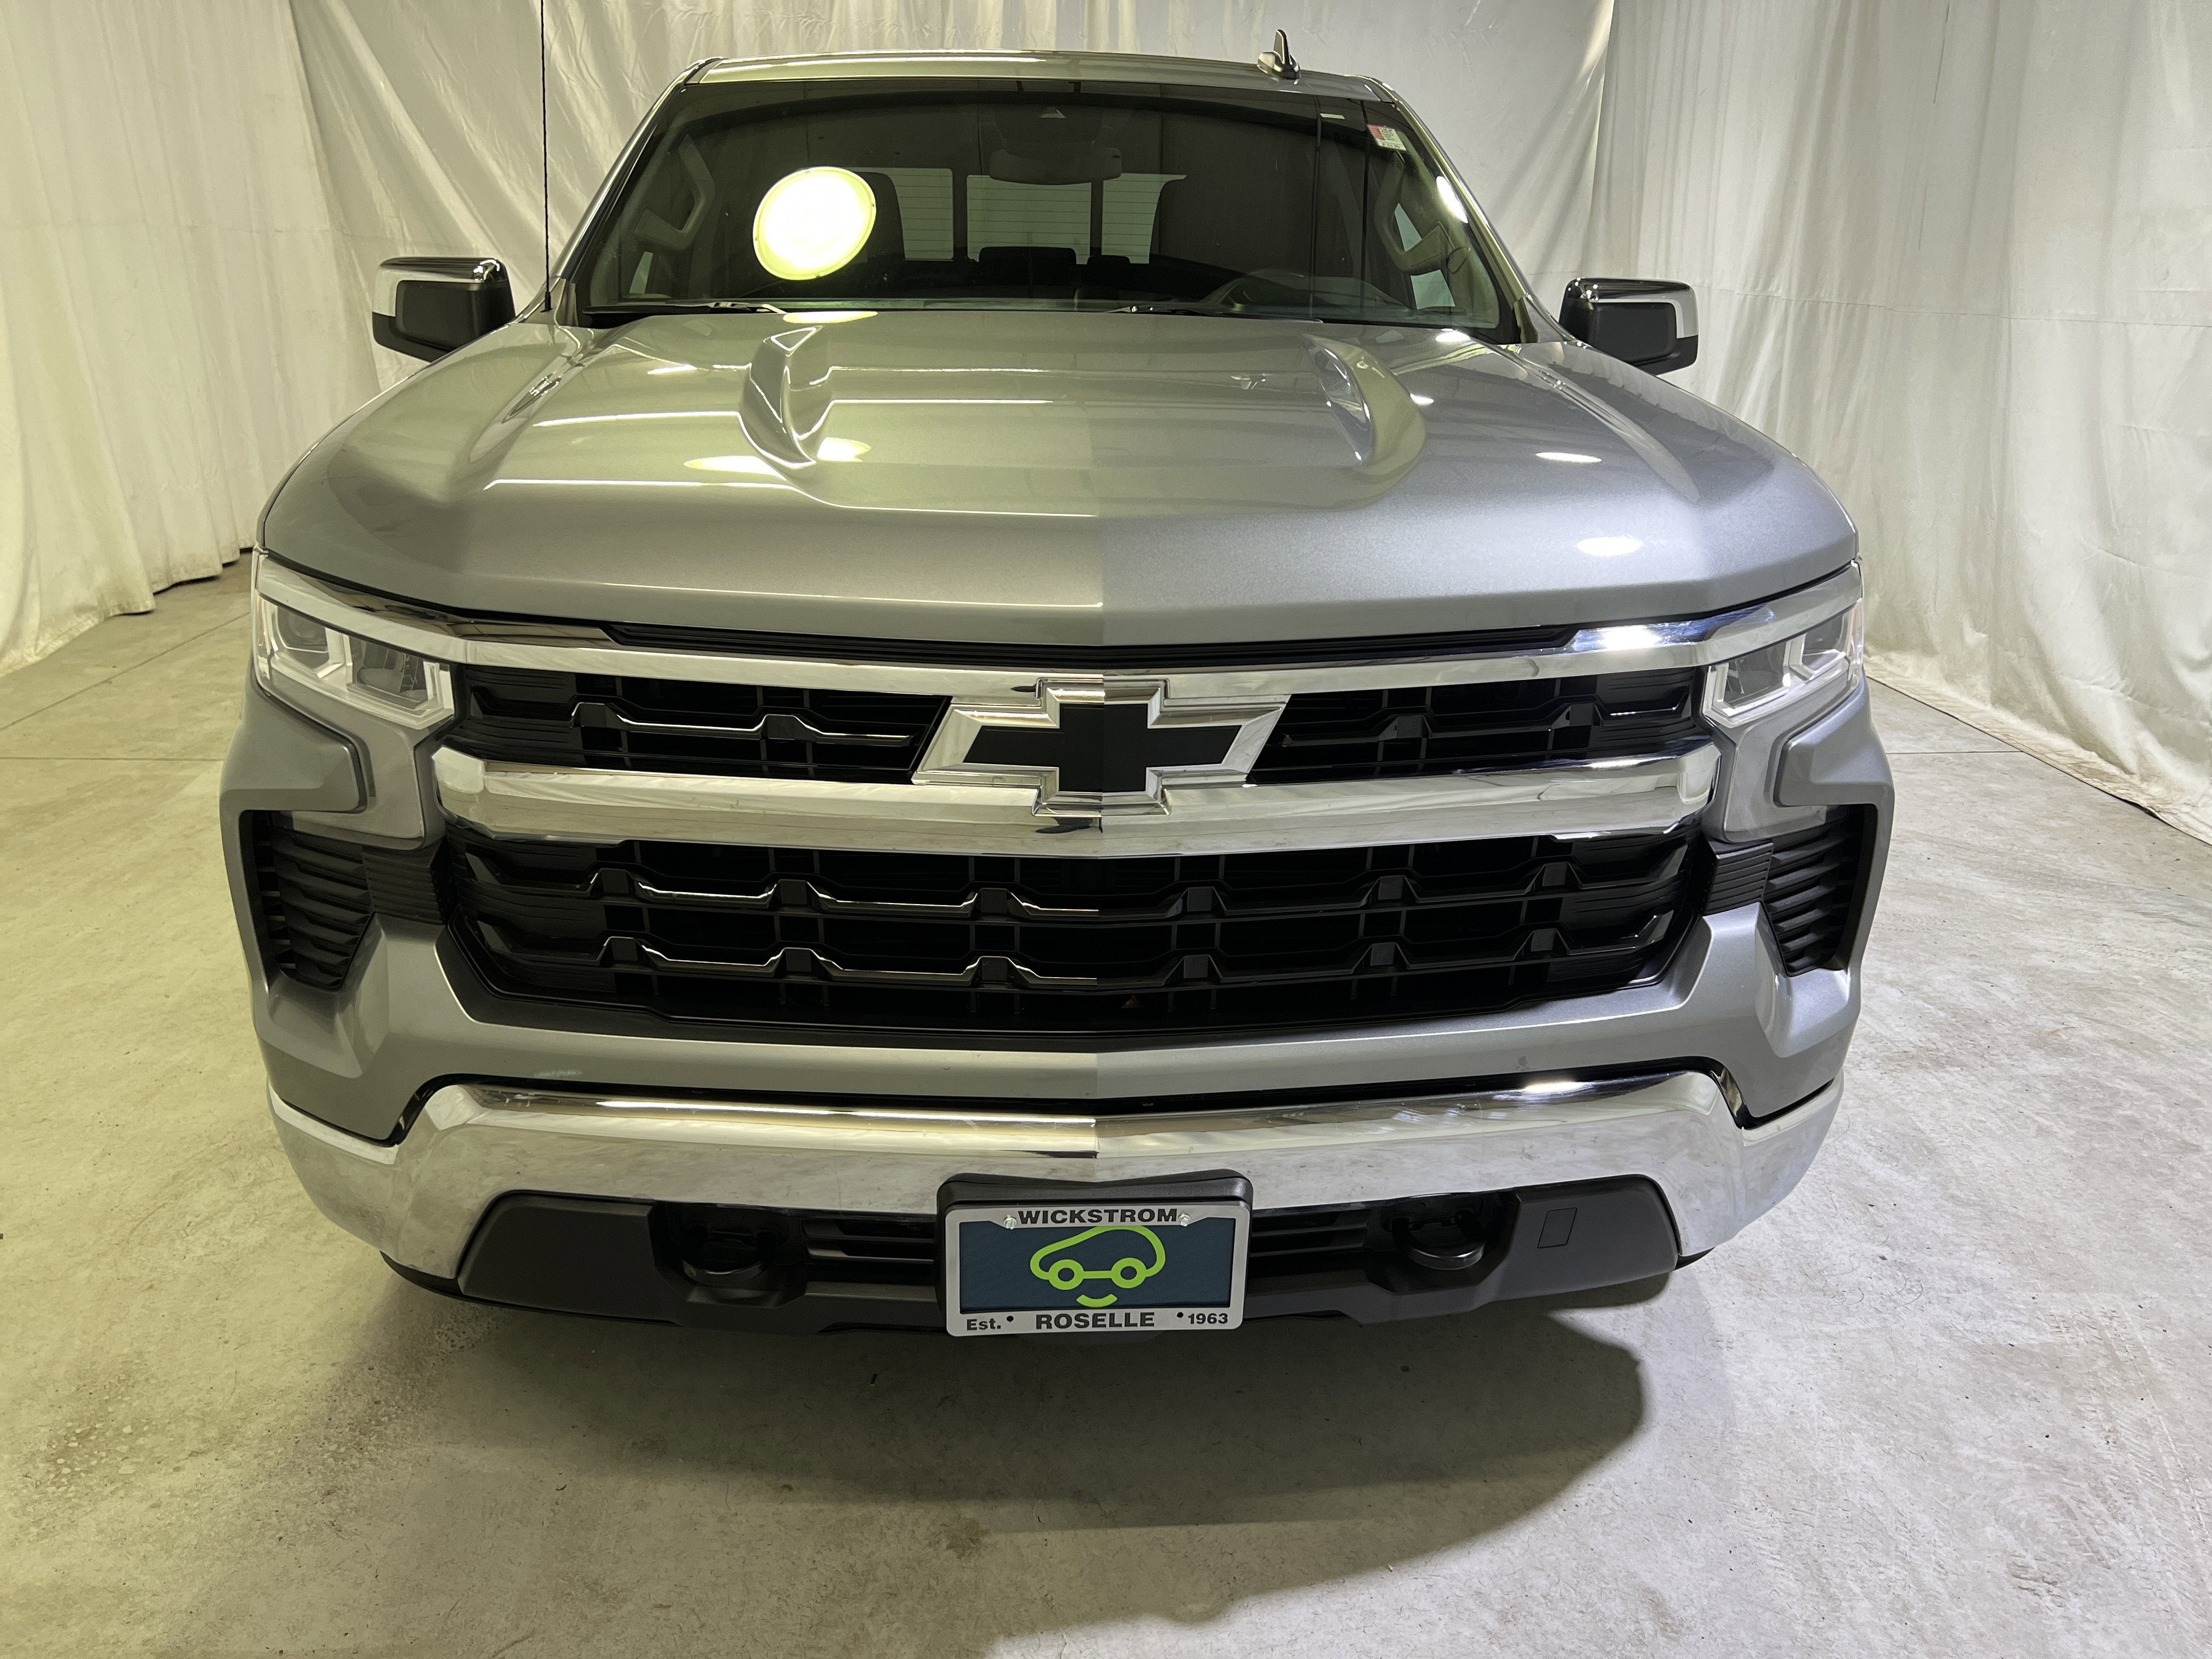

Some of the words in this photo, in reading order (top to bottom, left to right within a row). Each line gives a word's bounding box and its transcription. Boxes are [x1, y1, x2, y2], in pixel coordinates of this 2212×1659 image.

[1018, 1209, 1177, 1224] WICKSTROM
[966, 1319, 1002, 1330] Est.
[1036, 1312, 1155, 1329] ROSELLE
[1188, 1313, 1229, 1324] 1963
